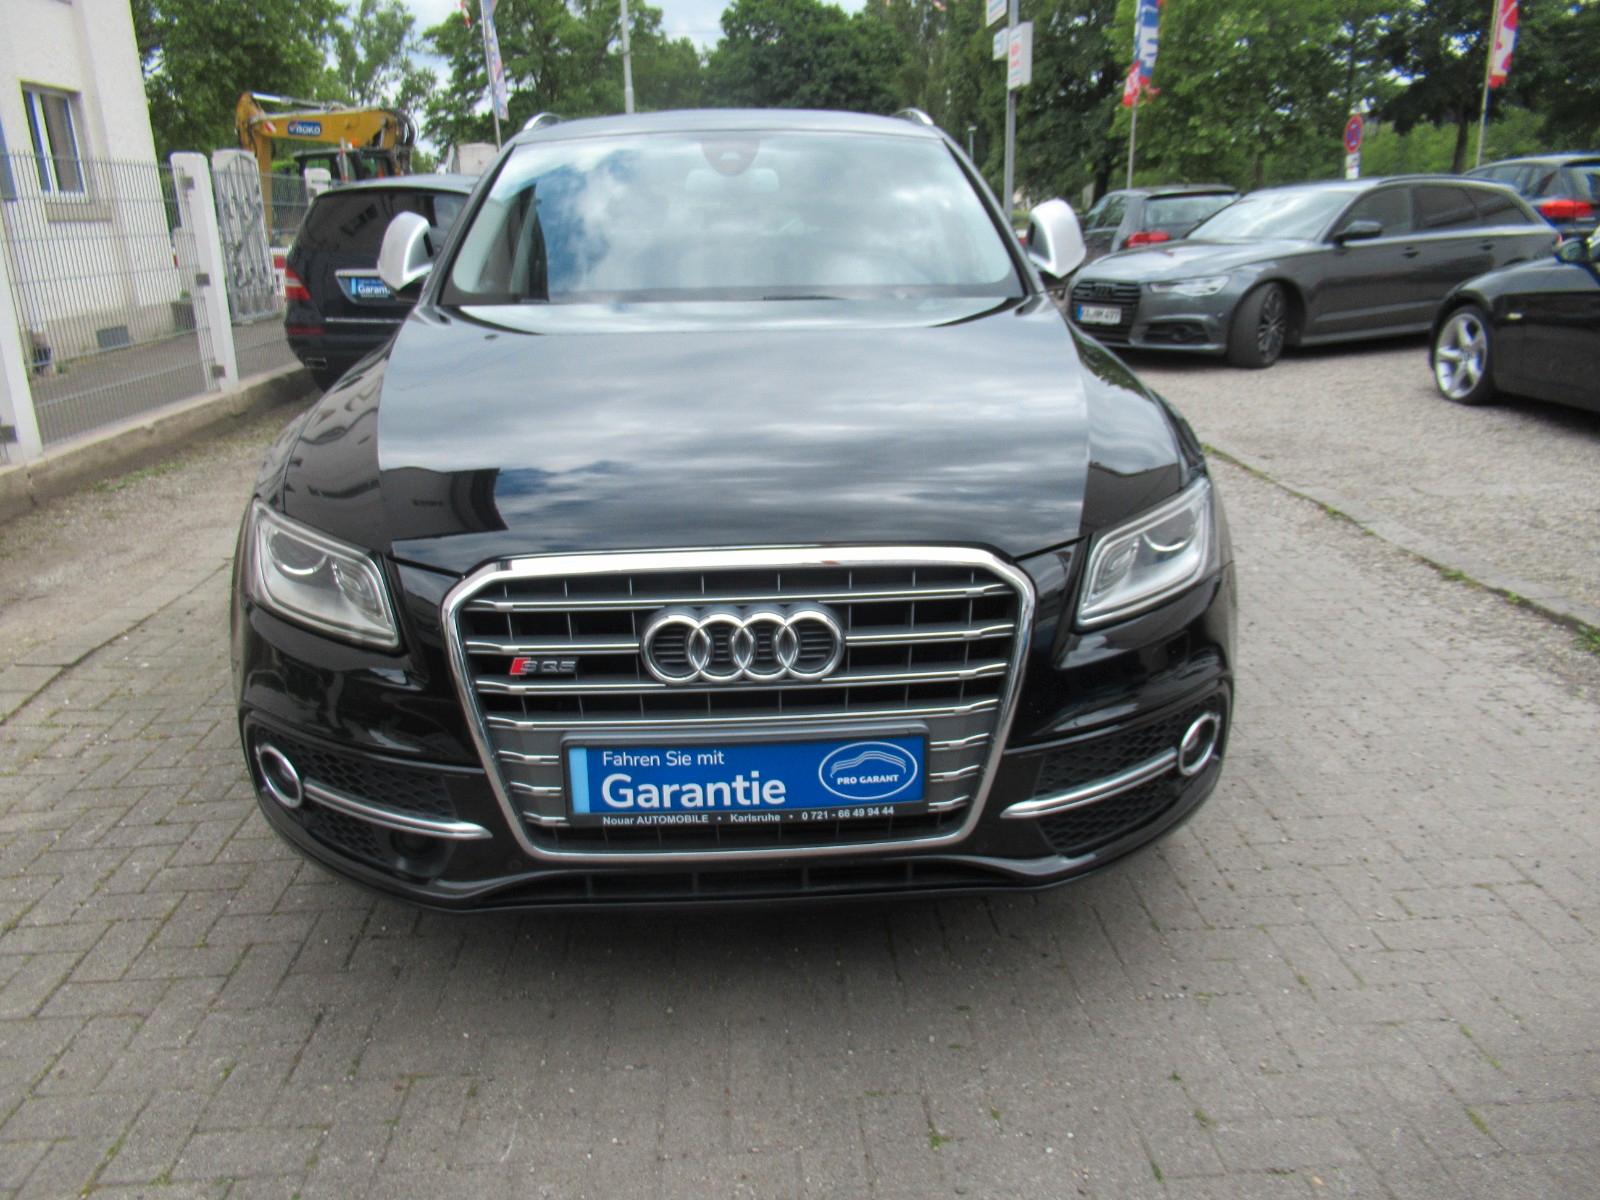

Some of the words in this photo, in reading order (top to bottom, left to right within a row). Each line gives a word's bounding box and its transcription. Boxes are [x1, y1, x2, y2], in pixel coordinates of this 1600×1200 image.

[602, 750, 661, 767] Fahren
[665, 750, 692, 767] Sie
[697, 749, 725, 766] mit
[601, 770, 787, 809] Garantie
[836, 777, 858, 786] PRO
[859, 774, 900, 785] GARANT
[602, 815, 635, 826] Nouar
[636, 814, 709, 825] AUTOMOBILE
[730, 813, 781, 823] Karlsruhe
[801, 811, 808, 821] 0
[810, 810, 829, 820] 721
[881, 805, 895, 816] 44
